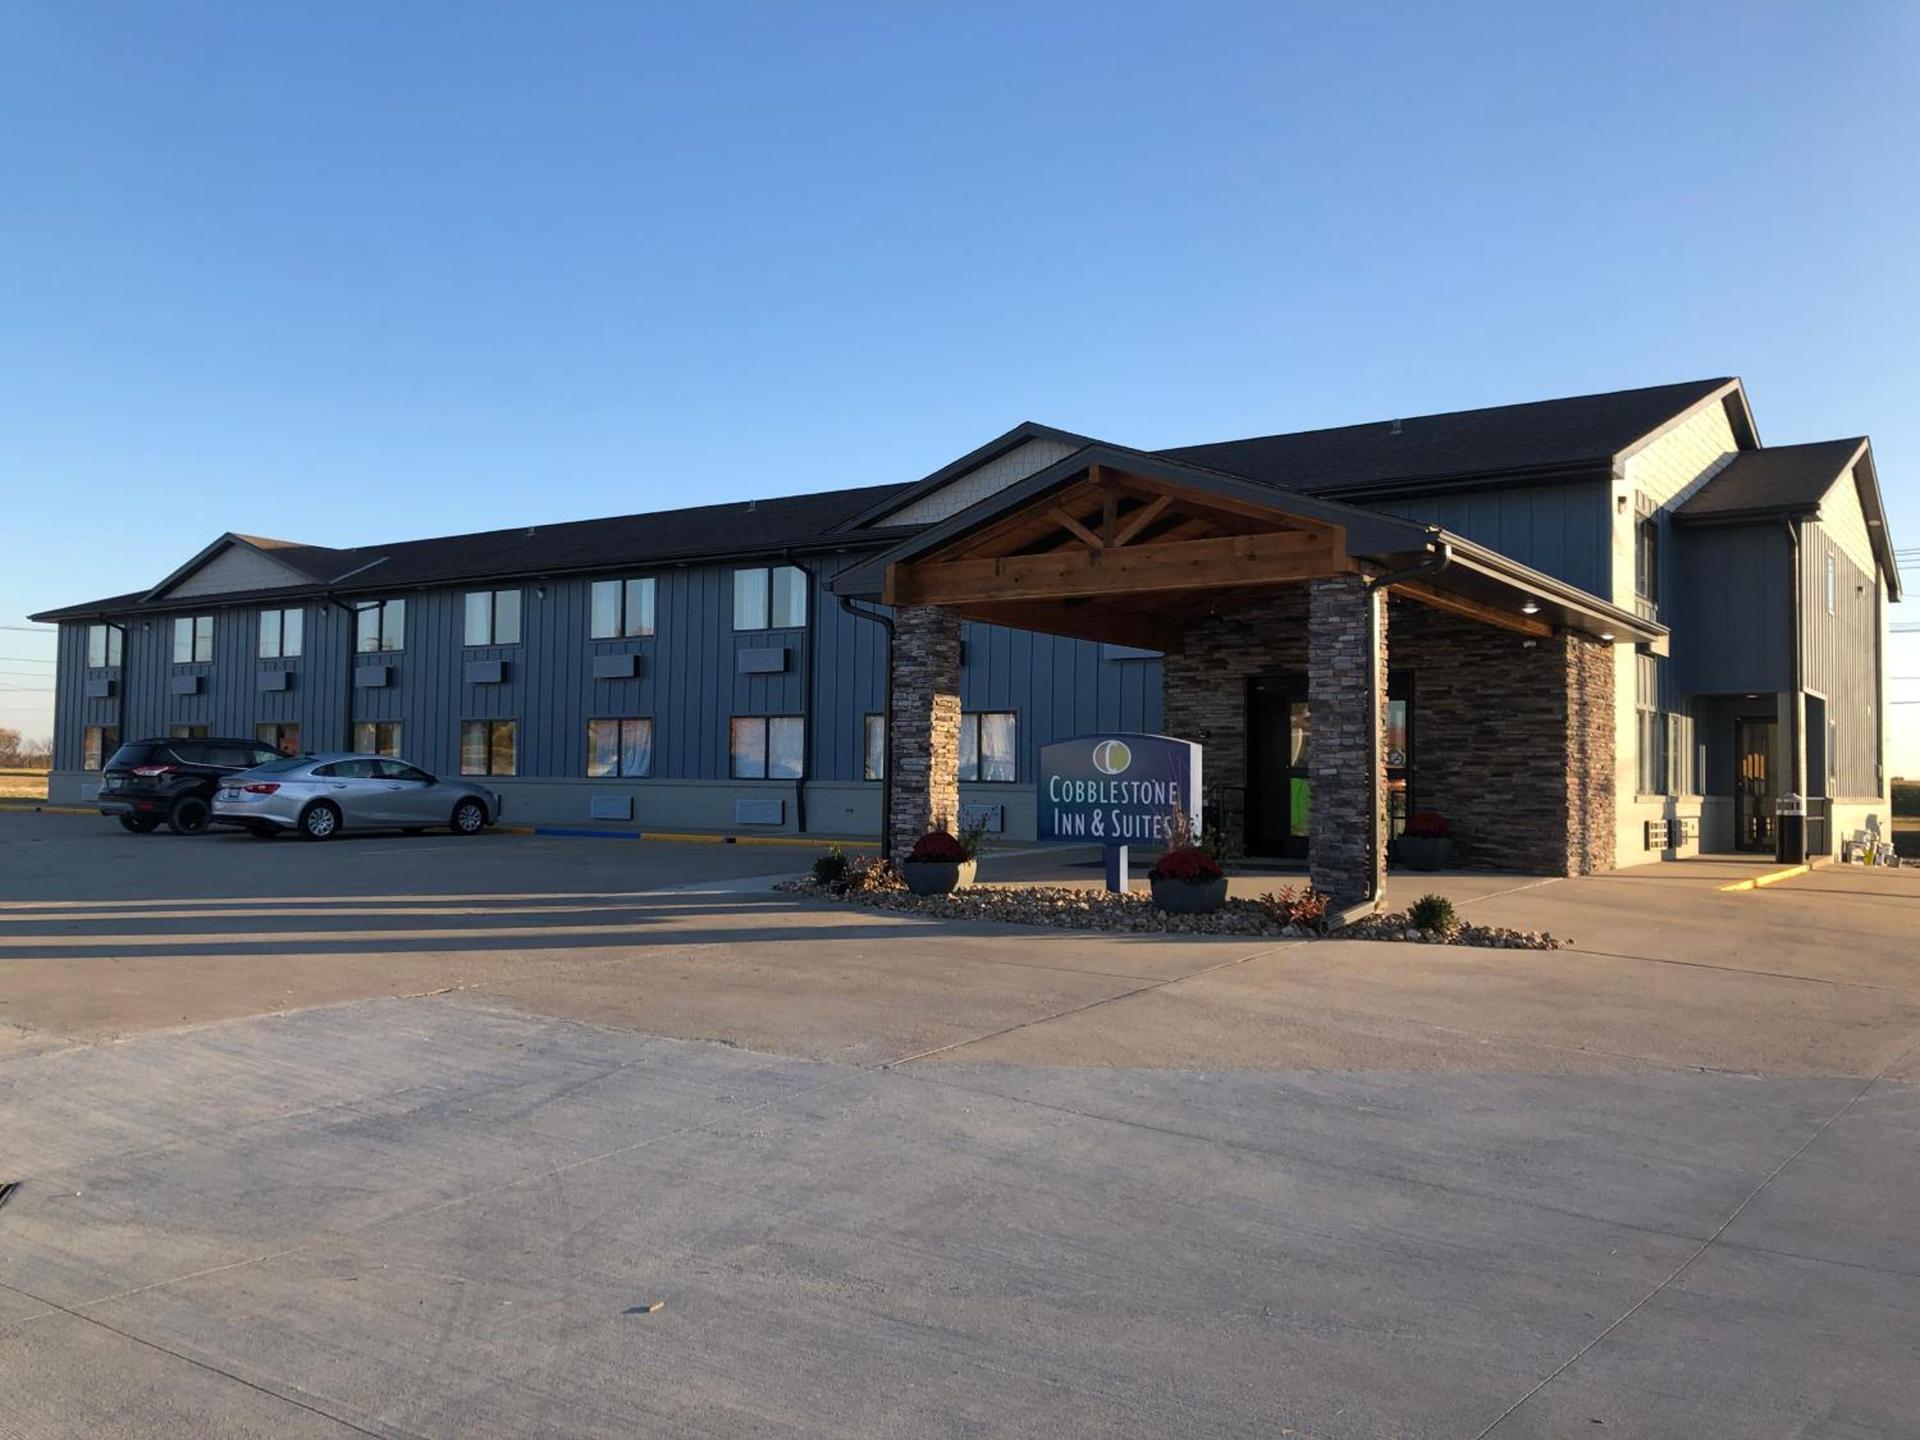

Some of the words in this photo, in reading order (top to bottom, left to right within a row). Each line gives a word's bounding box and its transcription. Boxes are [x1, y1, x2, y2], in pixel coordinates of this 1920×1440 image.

[1050, 775, 1178, 805] COBBLESTONE
[1054, 808, 1085, 836] INN
[1091, 809, 1105, 837] &
[1112, 810, 1172, 839] SUITES
